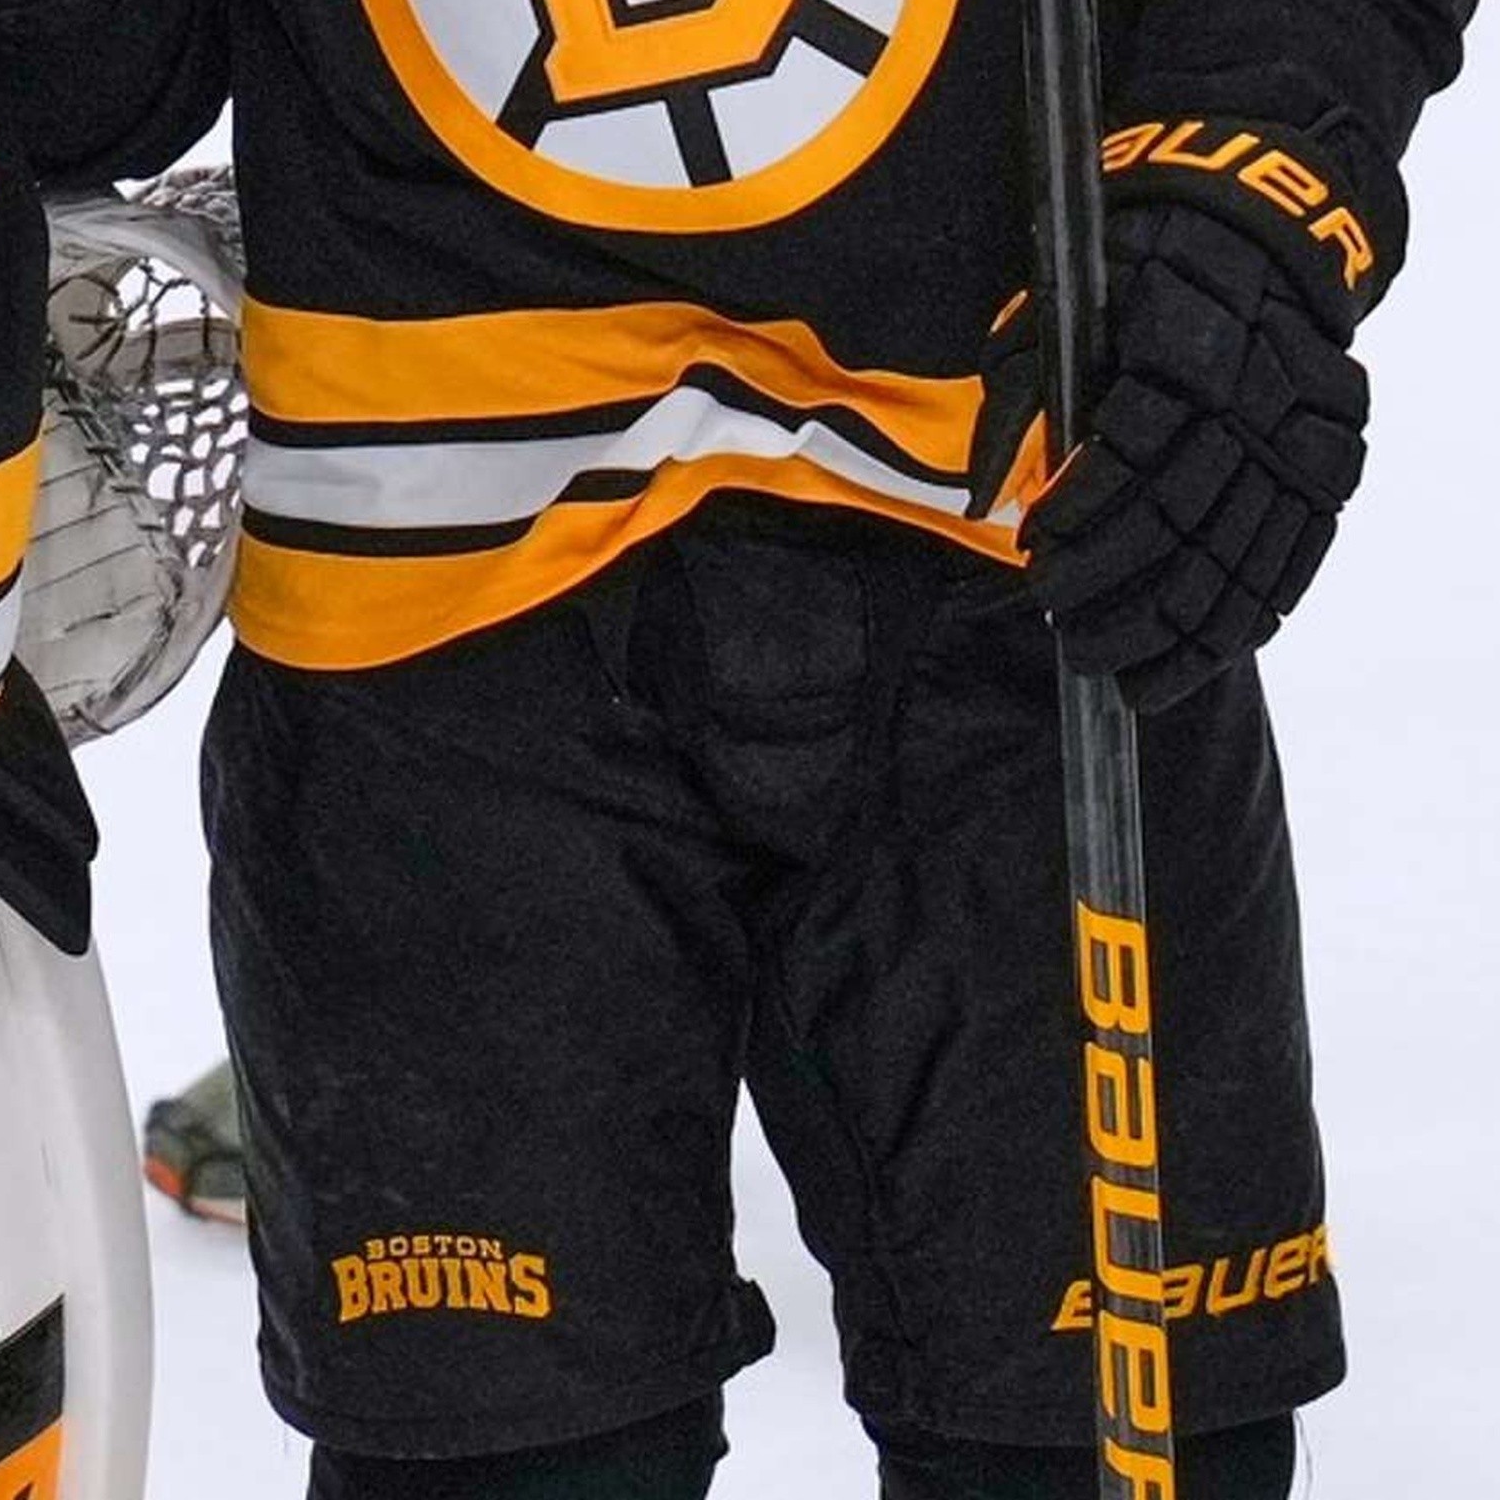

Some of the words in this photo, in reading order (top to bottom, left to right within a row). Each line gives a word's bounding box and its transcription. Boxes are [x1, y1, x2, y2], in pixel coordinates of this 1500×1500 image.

[1102, 122, 1374, 290] AUER
[365, 1234, 504, 1260] BOSTON
[331, 1252, 552, 1323] BRUINS
